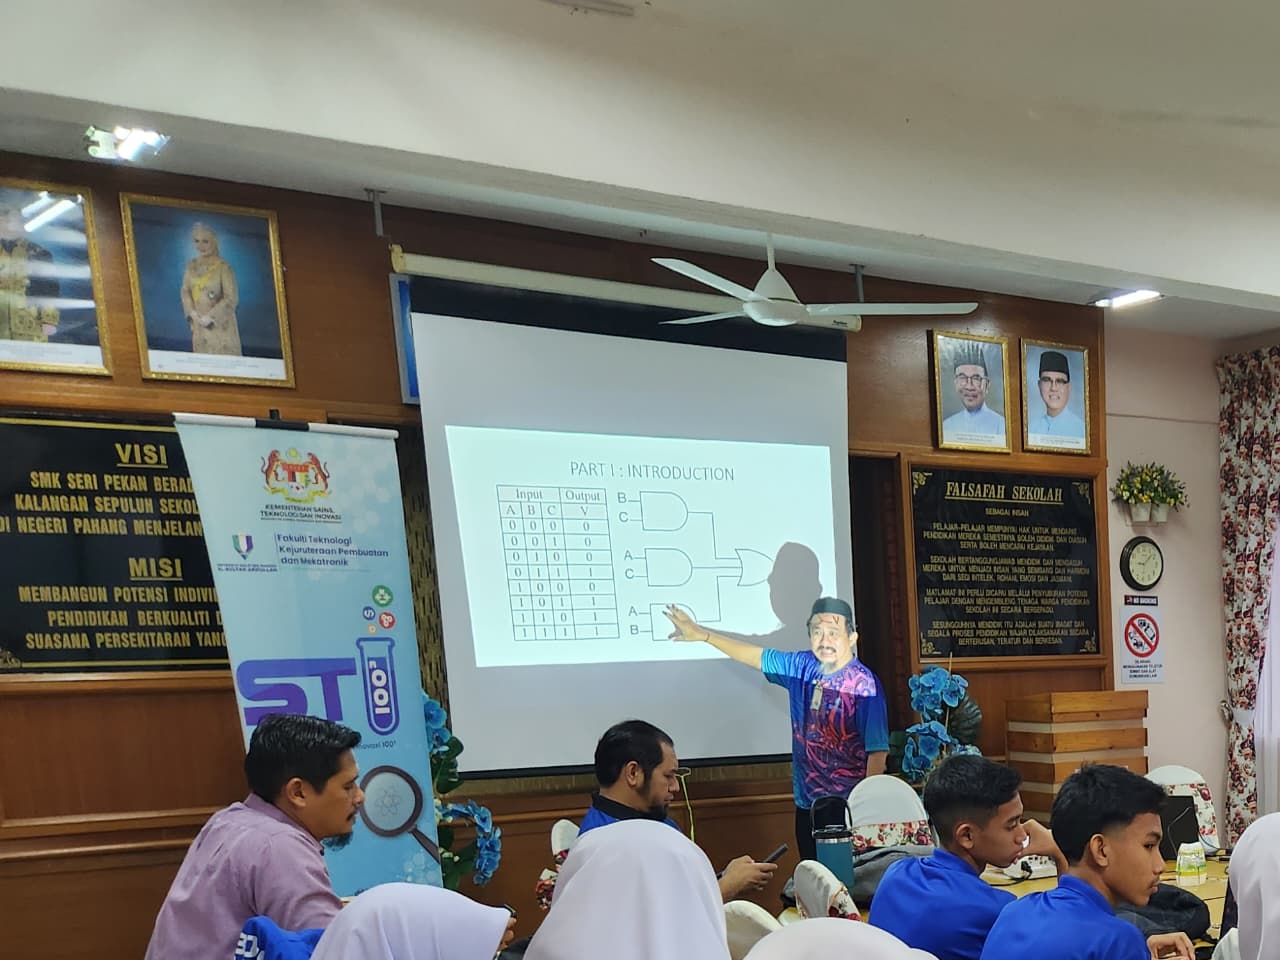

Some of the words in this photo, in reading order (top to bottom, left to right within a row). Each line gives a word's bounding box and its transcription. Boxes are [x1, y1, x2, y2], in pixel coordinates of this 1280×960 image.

[115, 443, 166, 465] VISI
[570, 461, 606, 476] PART
[628, 464, 735, 481] INTRODUCTION
[30, 472, 61, 488] SMK
[67, 473, 98, 490] SERI
[104, 475, 147, 491] PEKAN
[516, 488, 543, 502] Input
[566, 490, 600, 504] Output
[946, 482, 1005, 498] FALSAFAH
[1012, 486, 1062, 501] SEKOLAH
[618, 492, 627, 503] B
[15, 494, 88, 512] KALANGAN
[95, 496, 154, 514] SEPULUH
[506, 505, 515, 515] A
[528, 505, 536, 515] B
[547, 505, 556, 515] C
[619, 512, 629, 523] C
[17, 517, 67, 534] NEGERI
[74, 518, 128, 535] PAHANG
[509, 520, 516, 530] 0
[530, 521, 536, 530] 0
[550, 520, 556, 530] 0
[583, 522, 590, 531] 0
[277, 534, 307, 543] Fakulti
[309, 536, 352, 546] Teknologi
[511, 536, 518, 546] 0
[532, 537, 538, 546] 0
[552, 537, 556, 546] 1
[584, 538, 591, 547] 0
[280, 546, 337, 556] Kejuruteraan
[339, 548, 389, 557] Pembuatan
[513, 552, 520, 562] 0
[535, 552, 539, 562] 1
[553, 552, 560, 561] 0
[586, 552, 592, 561] 0
[624, 551, 633, 561] A
[128, 557, 182, 577] MISI
[300, 558, 348, 566] Mekatronik
[515, 568, 521, 577] 0
[537, 568, 540, 577] 1
[557, 568, 560, 577] 1
[589, 568, 592, 577] 1
[625, 568, 634, 579] C
[518, 582, 522, 592] 1
[537, 583, 544, 592] 0
[557, 582, 563, 592] 0
[589, 582, 595, 592] 0
[18, 586, 107, 602] MEMBANGUN
[114, 587, 168, 602] POTENSI
[520, 598, 523, 607] 1
[539, 598, 546, 607] 0
[560, 597, 564, 607] 1
[592, 597, 595, 606] 1
[629, 607, 638, 616] A
[48, 610, 128, 626] PENDIDIKAN
[138, 610, 209, 626] BERKUALITI
[521, 613, 524, 623] 1
[542, 613, 545, 622] 1
[561, 613, 567, 622] 0
[594, 612, 597, 621] 1
[523, 628, 526, 637] 1
[544, 628, 547, 637] 1
[564, 628, 567, 636] 1
[596, 627, 598, 636] 1
[630, 624, 639, 635] B
[25, 633, 89, 649] SUASANA
[96, 632, 190, 648] PERSEKITARAN
